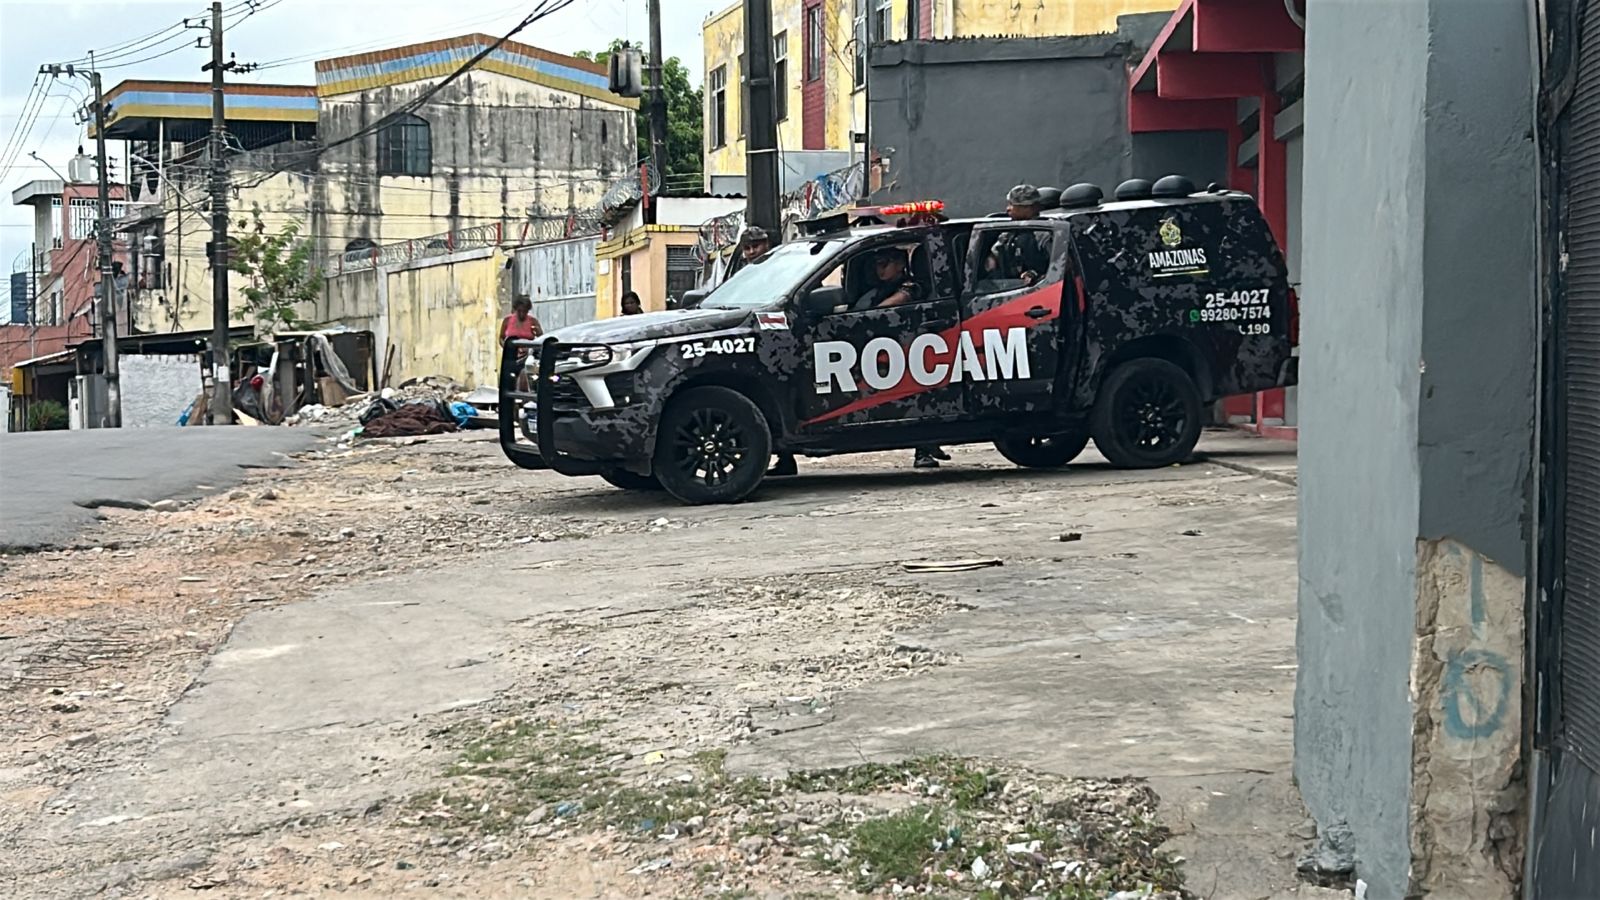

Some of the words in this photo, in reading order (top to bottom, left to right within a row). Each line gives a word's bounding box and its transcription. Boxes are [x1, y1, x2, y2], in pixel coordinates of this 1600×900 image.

[1148, 248, 1207, 268] AMAZONAS
[1205, 289, 1270, 308] 25-4027
[1200, 306, 1271, 321] 99280-7574
[1247, 323, 1270, 335] 190
[681, 338, 755, 359] 25-4027
[813, 327, 1031, 394] ROCAM
